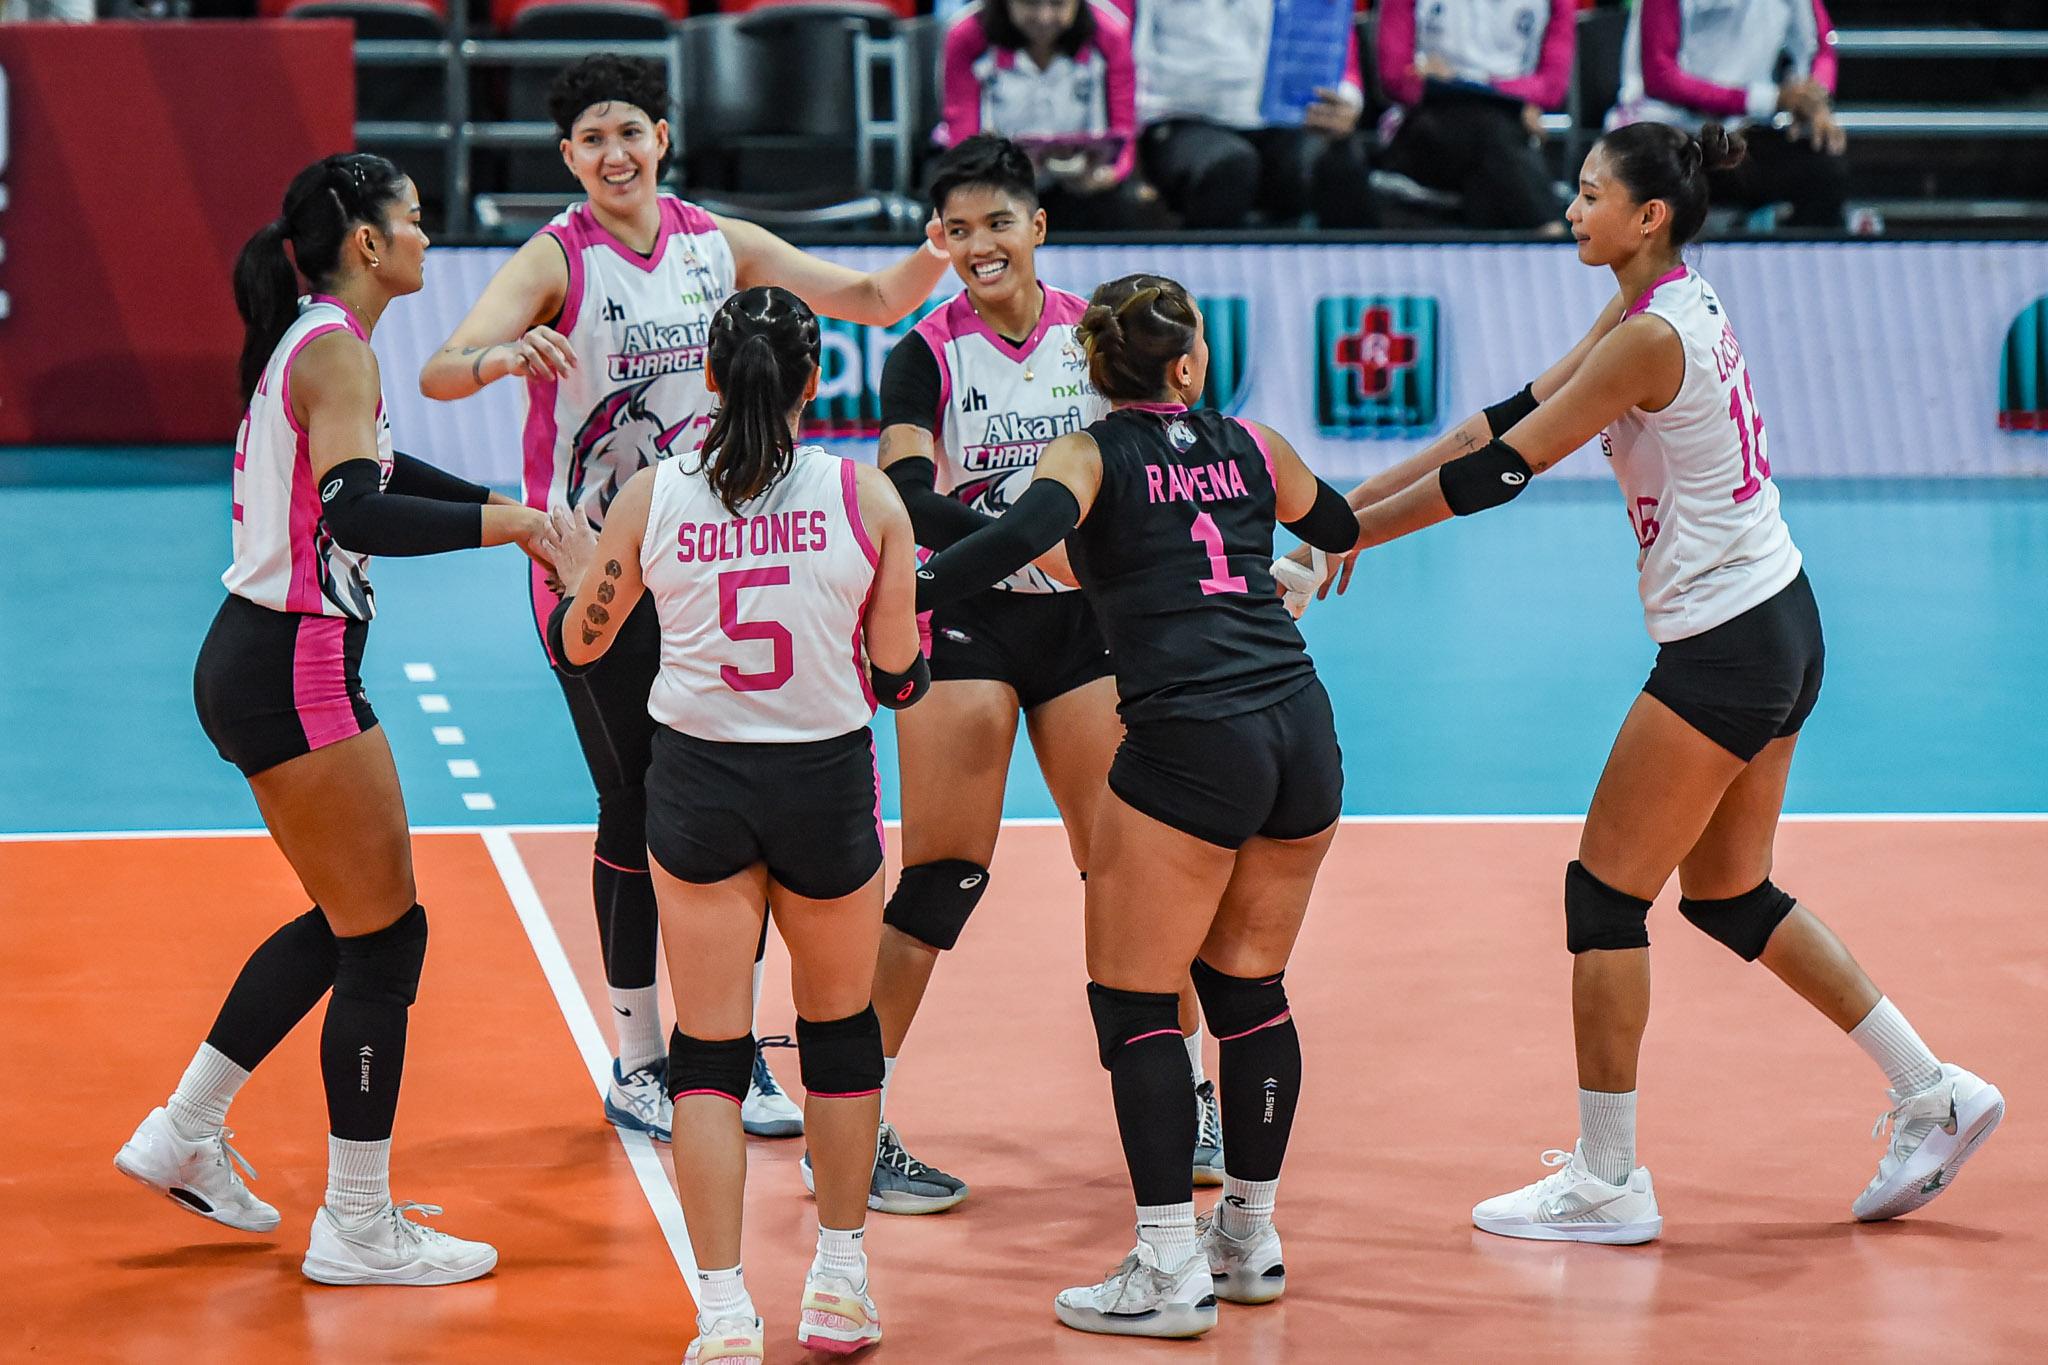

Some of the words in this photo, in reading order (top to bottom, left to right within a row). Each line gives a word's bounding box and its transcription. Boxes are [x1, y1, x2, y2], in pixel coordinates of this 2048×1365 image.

[622, 314, 708, 355] Akari
[982, 405, 1081, 446] Akari
[964, 442, 1050, 471] CHAR
[1145, 459, 1249, 503] RAVENA
[677, 510, 827, 562] SOLTONES
[1190, 511, 1249, 596] 1
[718, 565, 794, 691] 5
